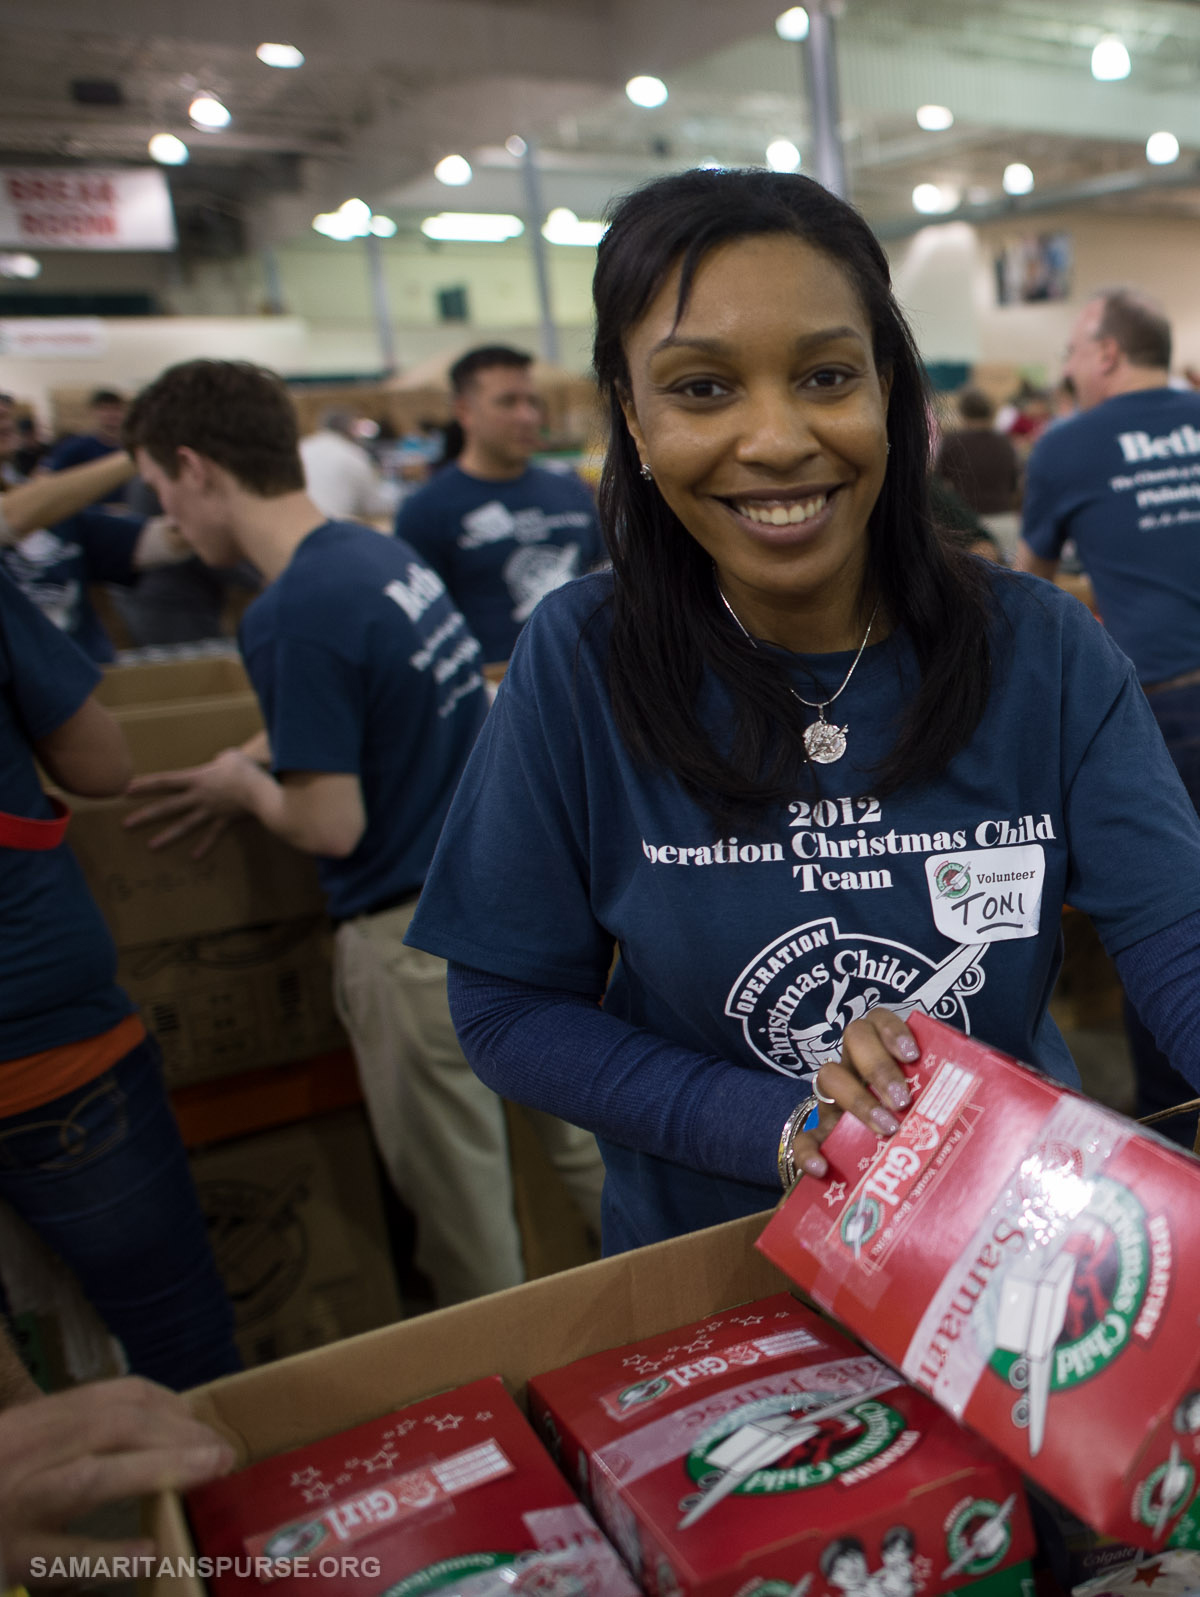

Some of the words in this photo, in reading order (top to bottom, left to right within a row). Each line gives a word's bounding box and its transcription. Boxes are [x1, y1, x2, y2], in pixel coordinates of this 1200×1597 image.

[787, 796, 883, 828] 2012
[642, 836, 785, 866] peration
[791, 826, 967, 859] Christmas
[974, 813, 1057, 847] Child
[792, 863, 894, 893] Team
[976, 869, 1036, 884] Volunteer
[950, 891, 1025, 926] TONI
[736, 928, 830, 1013] OPERATION
[758, 962, 831, 1071] Christmas
[833, 949, 921, 994] Child
[864, 1145, 921, 1207] Girl
[1055, 1312, 1128, 1385] Child
[666, 1355, 729, 1388] Girl
[323, 1488, 400, 1541] Girl
[1082, 1547, 1136, 1568] Colgate
